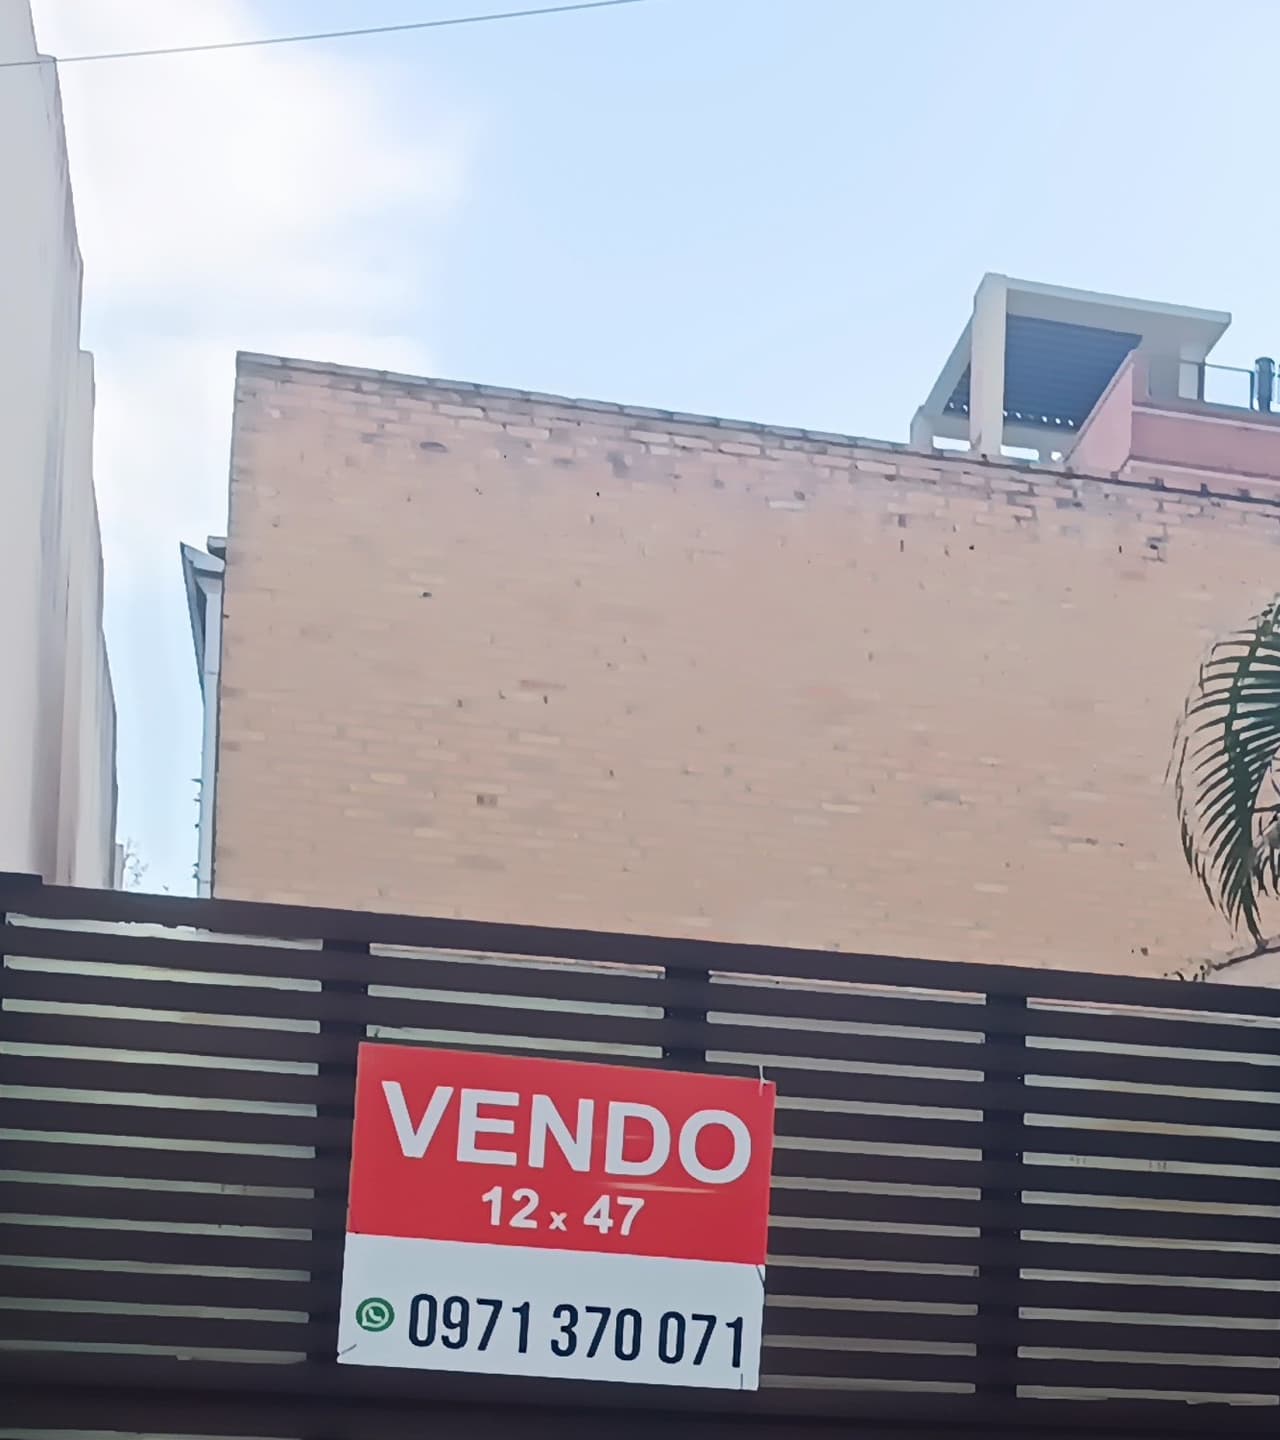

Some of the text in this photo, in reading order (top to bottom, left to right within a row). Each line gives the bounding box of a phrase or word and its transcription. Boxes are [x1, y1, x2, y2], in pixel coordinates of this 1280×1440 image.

[381, 1080, 752, 1184] VENDO
[481, 1186, 645, 1236] 12 x 47
[408, 1293, 744, 1368] 0971 370 071
